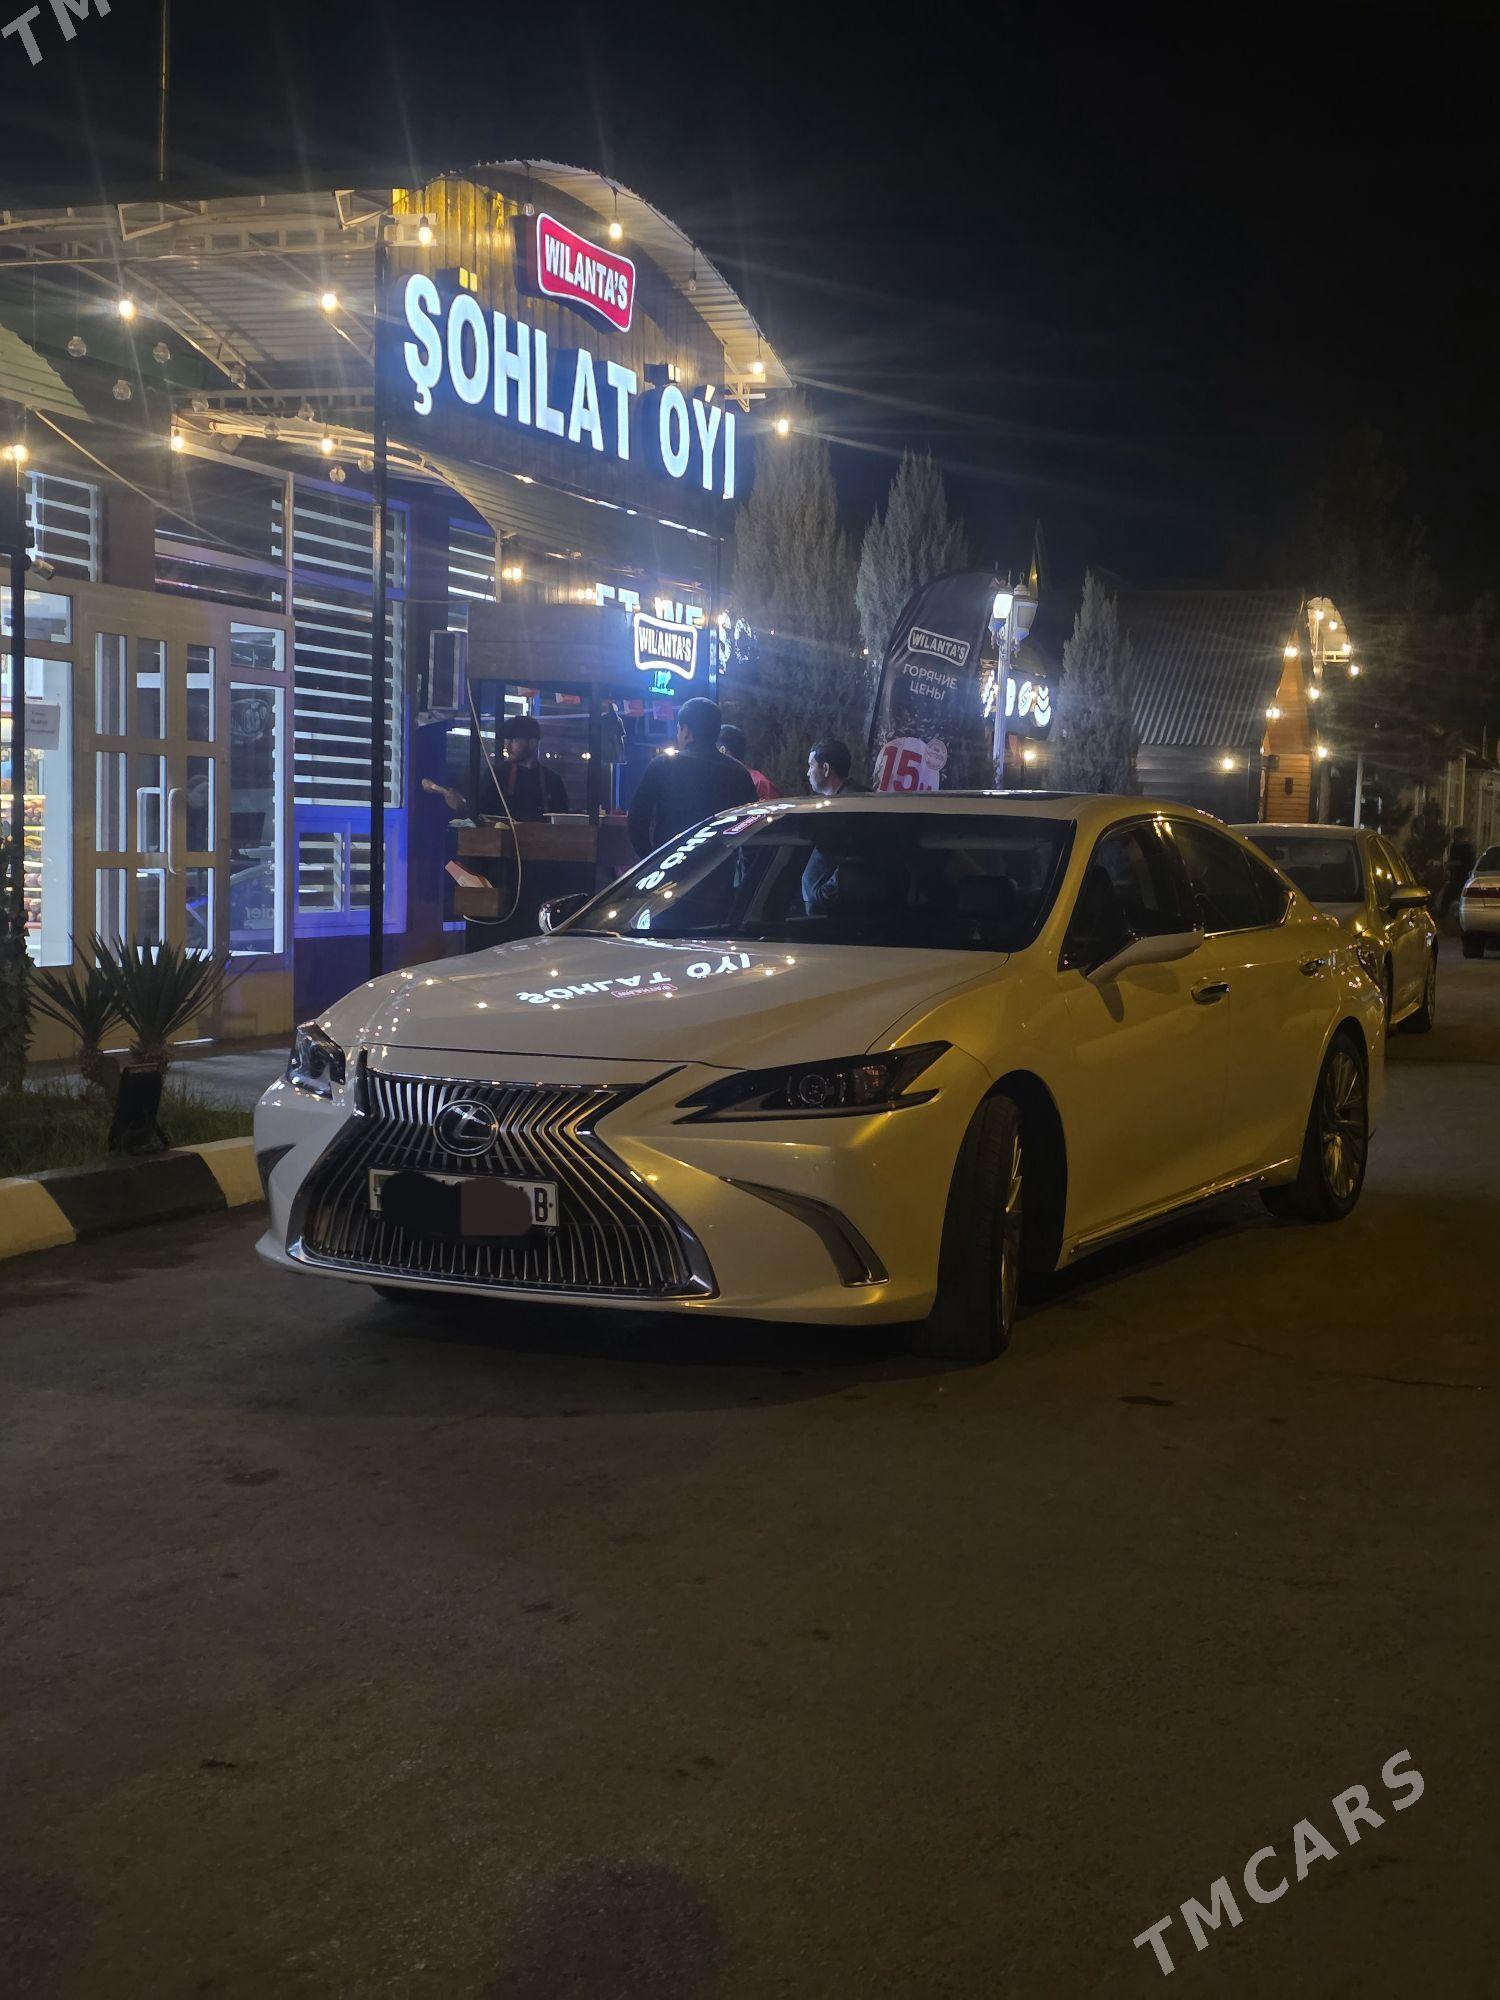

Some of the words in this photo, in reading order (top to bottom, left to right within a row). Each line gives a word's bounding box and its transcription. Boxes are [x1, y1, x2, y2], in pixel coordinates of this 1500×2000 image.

[545, 234, 628, 310] WILANTA'S
[404, 267, 638, 461] ŞÖHLAT
[639, 626, 692, 662] WILANTA'S
[912, 631, 966, 660] WILANTA'S
[903, 663, 958, 690] ГОРЯЧИЕ
[910, 680, 946, 701] ЦЕНЫ
[880, 746, 922, 791] 15
